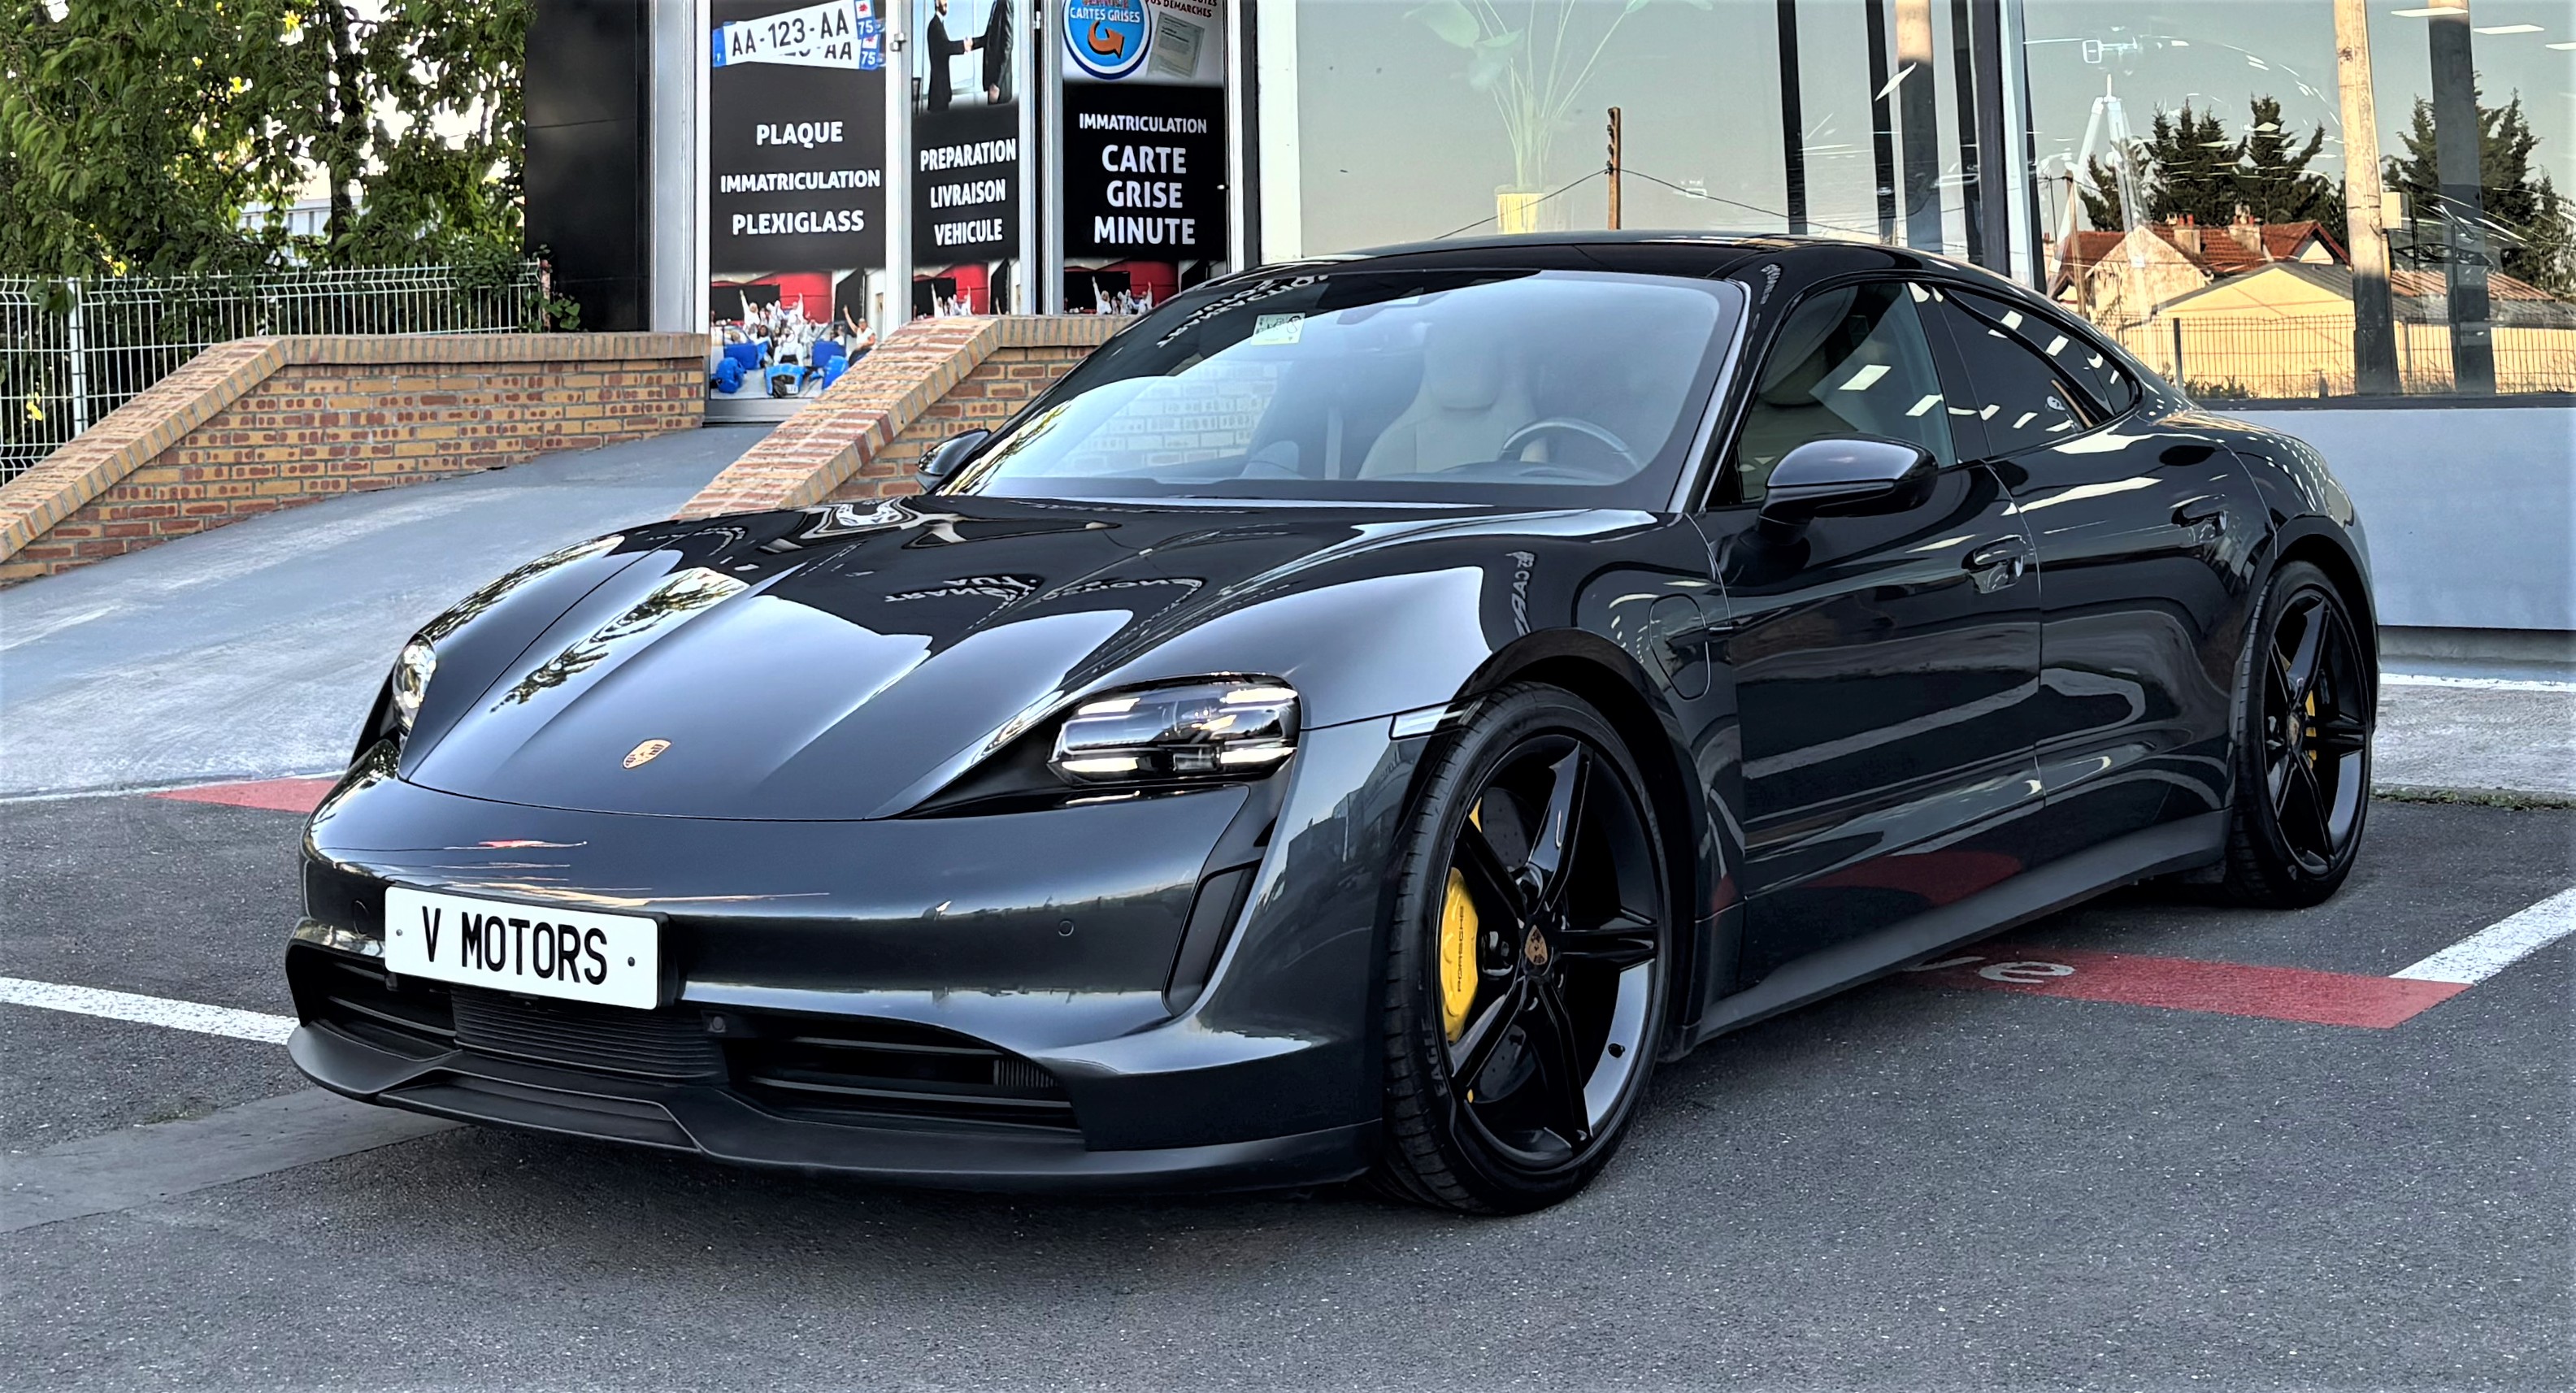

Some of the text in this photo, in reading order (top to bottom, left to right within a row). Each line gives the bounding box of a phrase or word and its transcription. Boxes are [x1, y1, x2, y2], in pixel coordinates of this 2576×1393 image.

[858, 20, 875, 35] 75
[1070, 7, 1140, 23] CARTES GRISES
[862, 51, 876, 65] 75
[756, 121, 844, 149] PLAQUE
[1079, 112, 1207, 134] IMMATRICULATION
[920, 137, 1017, 171] PREPARATION
[1101, 144, 1187, 174] CARTE
[720, 169, 881, 193] IMMATRICULATION
[930, 178, 1006, 209] LIVRAISON
[1106, 180, 1183, 209] GRISE
[732, 209, 865, 236] PLEXIGLASS
[933, 218, 1003, 246] VEHICULE
[1093, 215, 1196, 245] MINUTE
[422, 905, 608, 986] V MOTORS
[1457, 905, 1465, 993] PORSCHE
